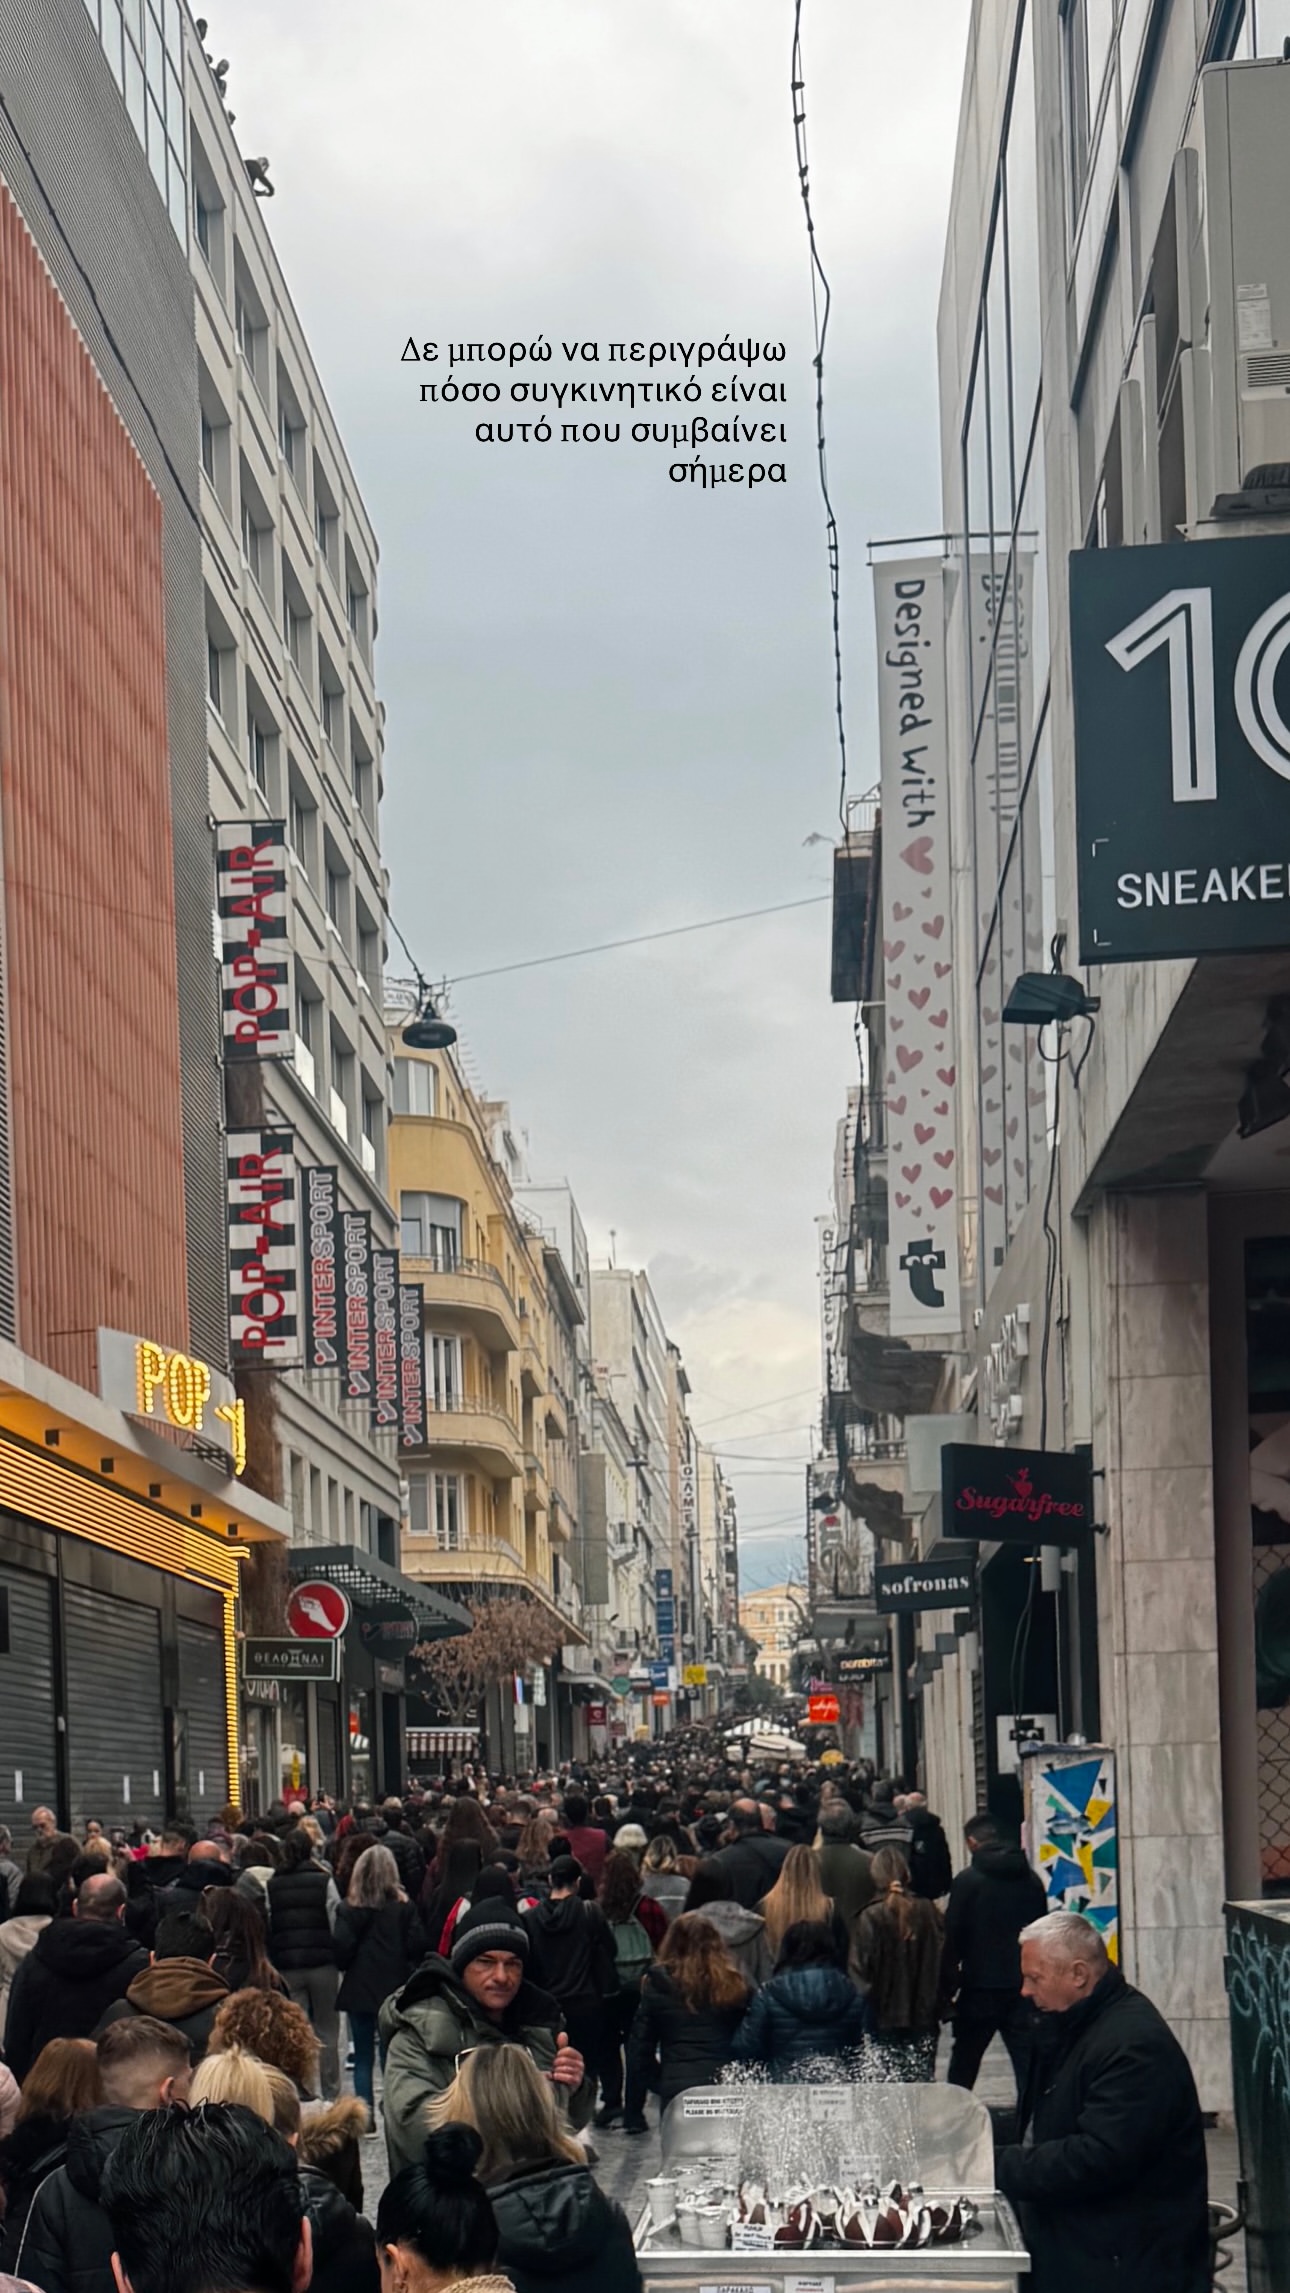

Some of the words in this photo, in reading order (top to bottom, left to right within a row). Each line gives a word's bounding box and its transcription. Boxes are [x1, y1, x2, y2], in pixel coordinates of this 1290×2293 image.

[885, 579, 932, 736] Designed
[901, 745, 935, 828] with
[228, 838, 279, 1044] POP-AIR
[1116, 863, 1290, 908] SNEAKE
[238, 1146, 286, 1349] POP-AIR
[309, 1168, 337, 1339] INTERSPORT
[344, 1212, 370, 1372] INTERSPORT
[138, 1341, 211, 1430] POP
[373, 1251, 396, 1400] INTERSPORT
[400, 1286, 422, 1425] INTERSPORT
[955, 1486, 1085, 1521] Sugarfree
[881, 1575, 969, 1596] sofronas
